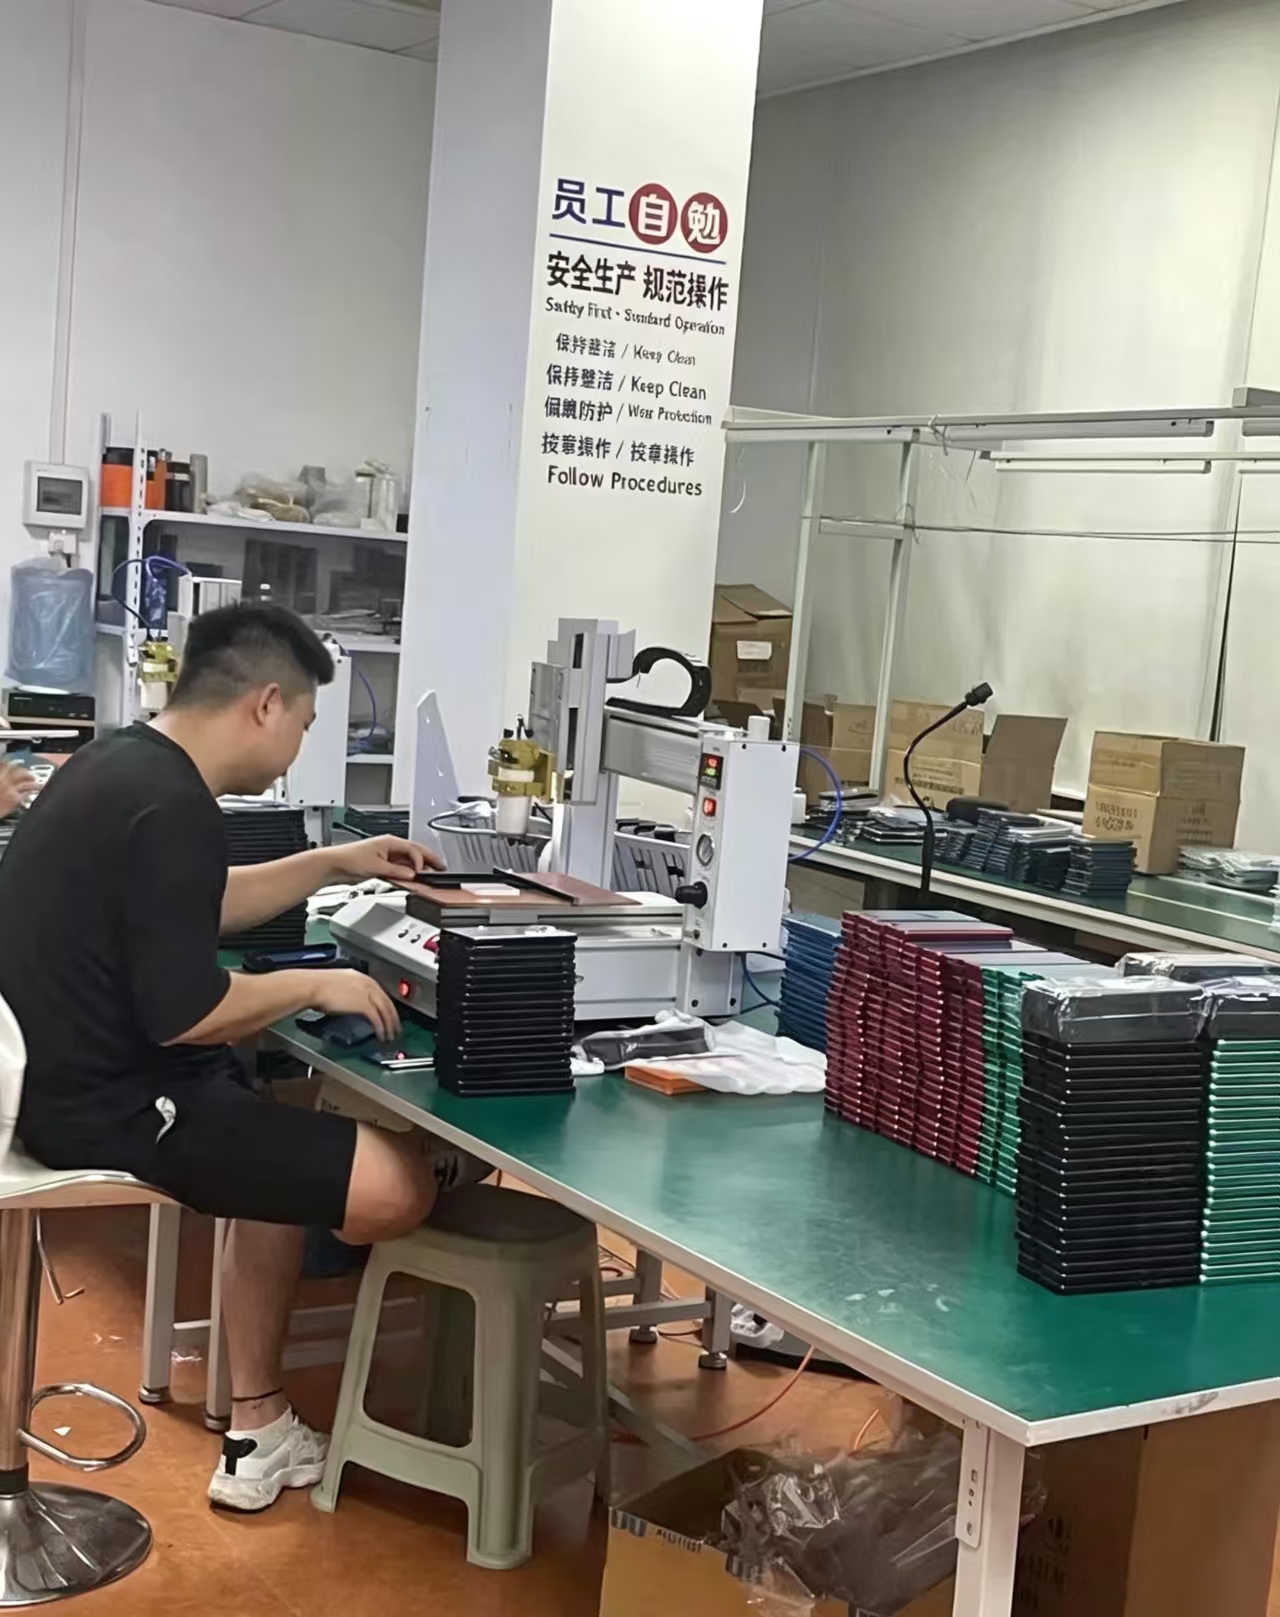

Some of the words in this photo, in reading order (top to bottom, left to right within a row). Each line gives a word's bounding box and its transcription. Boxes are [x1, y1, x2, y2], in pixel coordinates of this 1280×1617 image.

[552, 178, 722, 246] 员工自勉
[547, 251, 636, 295] 安全生产
[643, 264, 729, 311] 规范操作
[631, 375, 665, 399] Keep
[669, 380, 706, 401] Clean
[547, 464, 604, 488] Follow
[611, 471, 703, 497] Procedures
